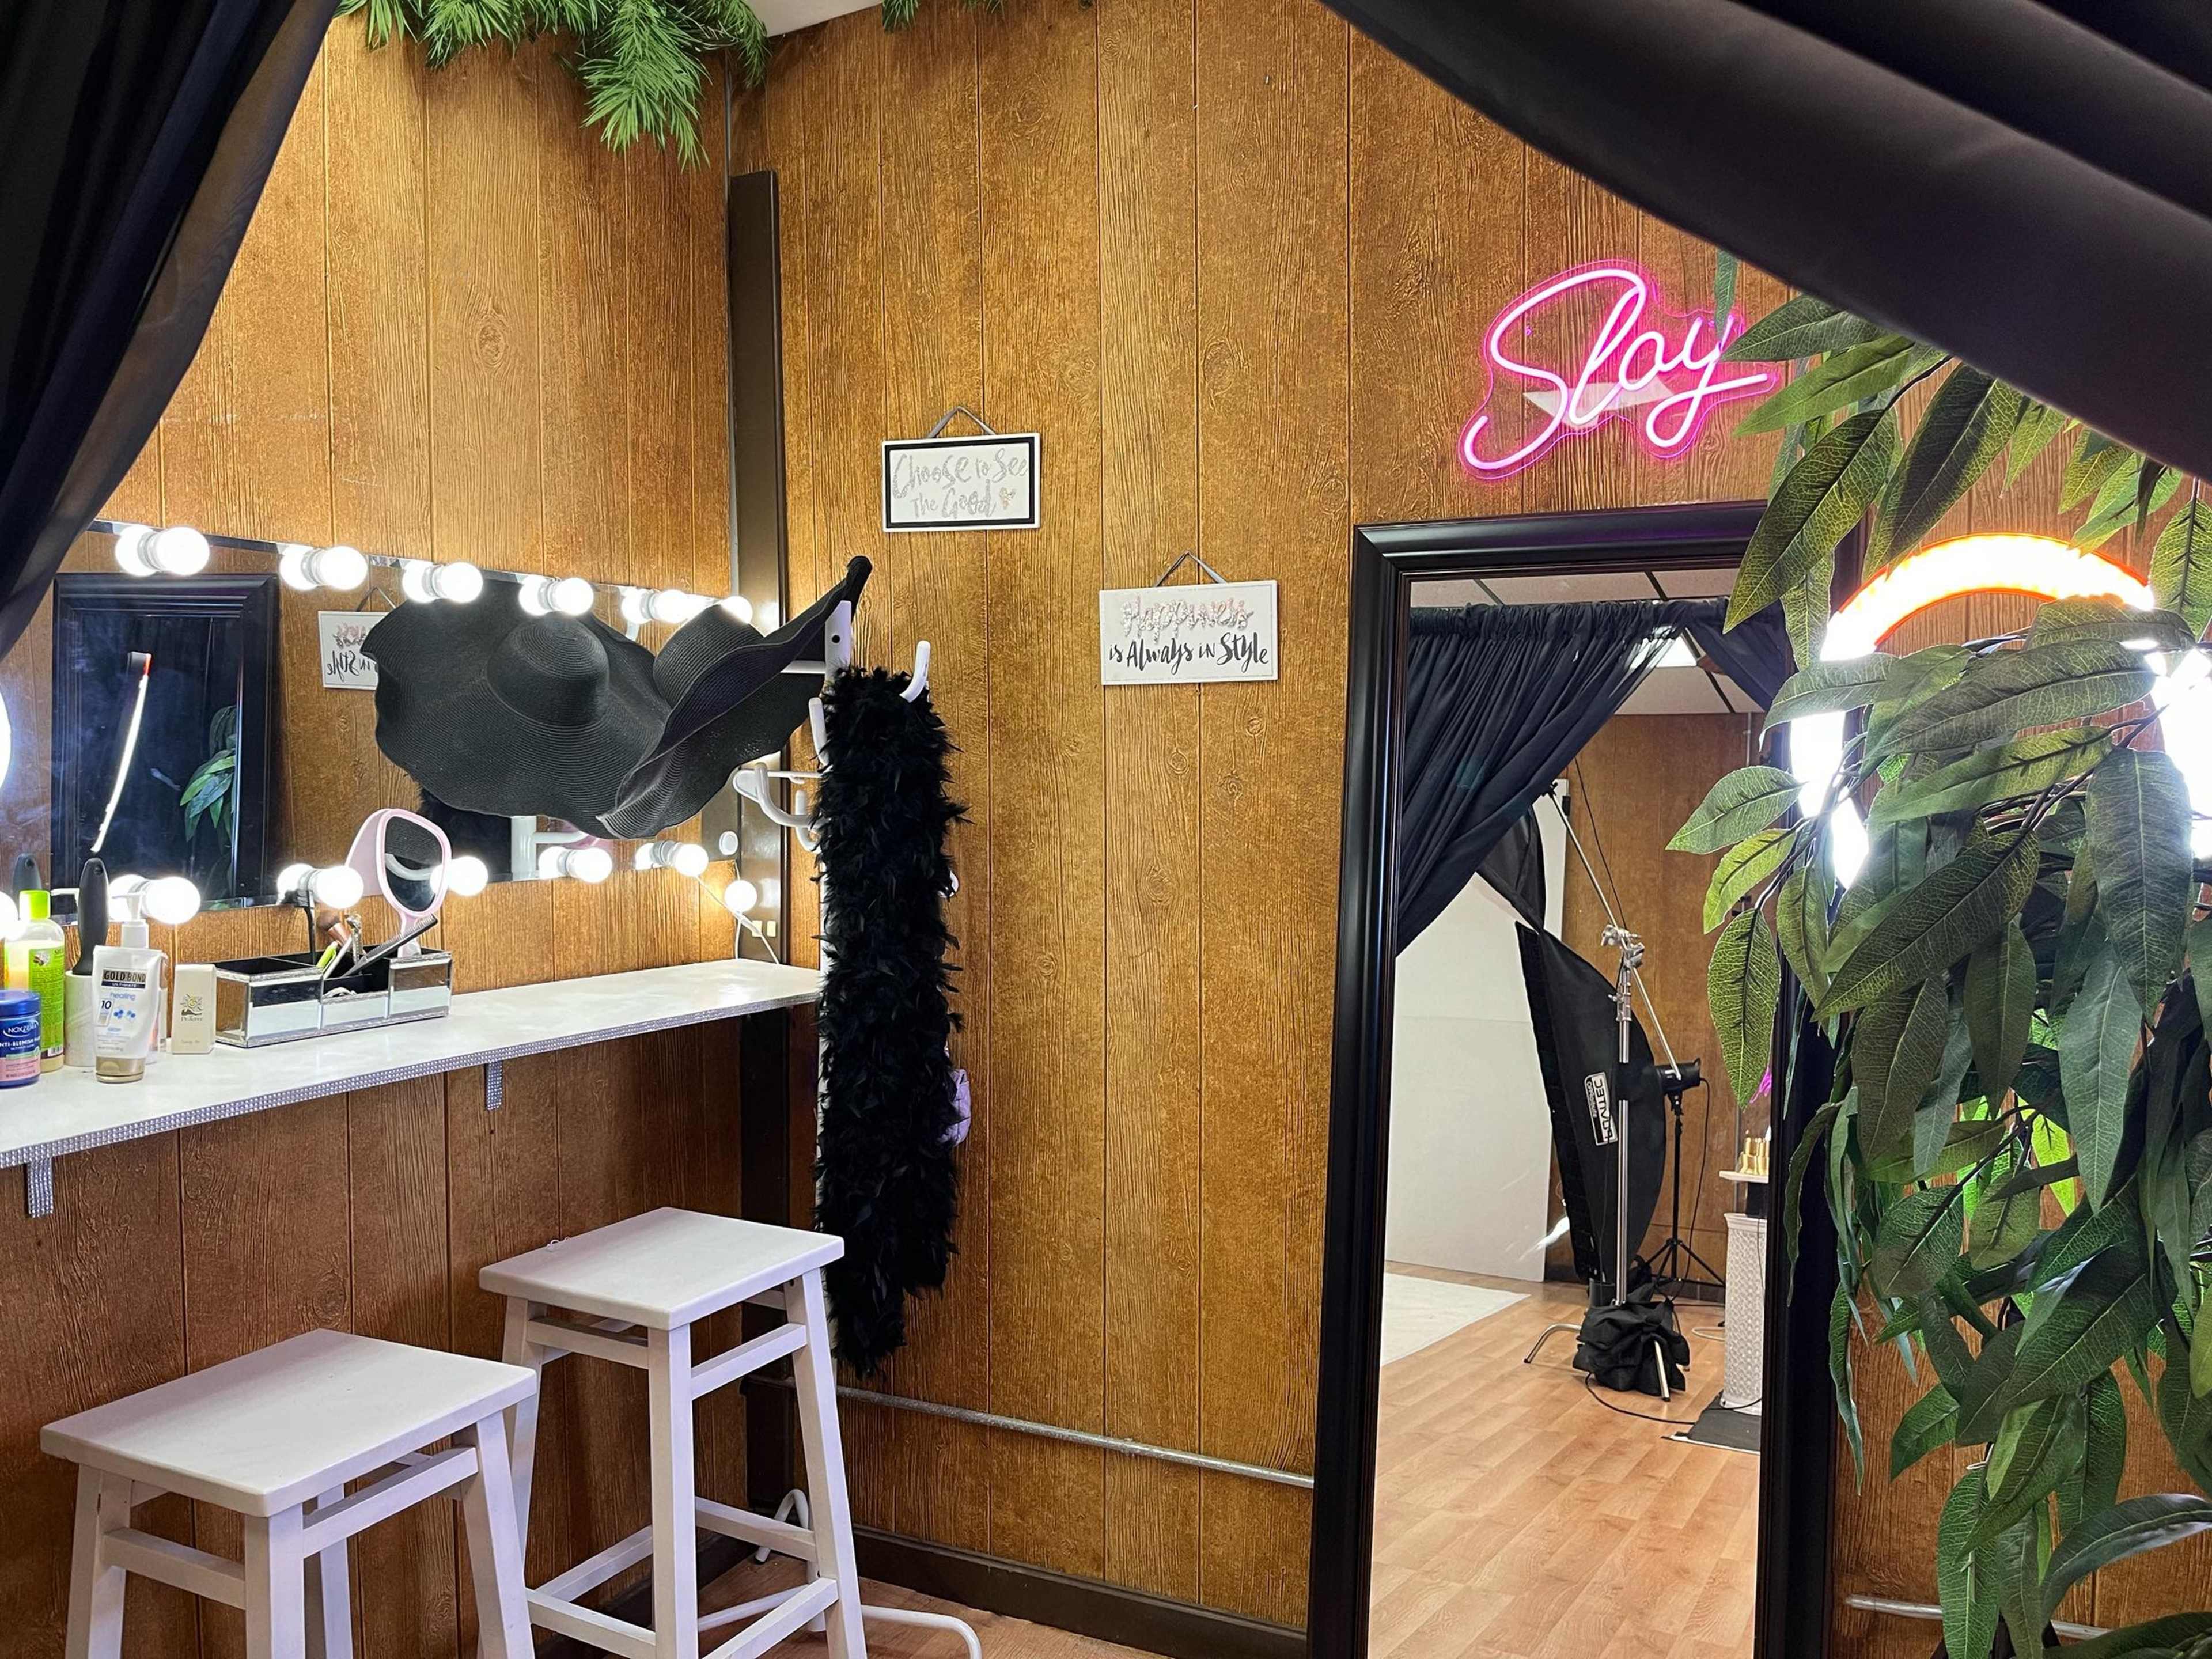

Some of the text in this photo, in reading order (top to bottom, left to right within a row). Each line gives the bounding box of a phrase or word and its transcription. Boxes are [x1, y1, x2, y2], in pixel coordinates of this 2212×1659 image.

[1464, 267, 1768, 471] Slay
[992, 448, 1028, 483] See
[941, 479, 997, 519] Good
[1109, 644, 1123, 662] is
[1127, 637, 1194, 675] Always
[1216, 632, 1268, 673] Style
[104, 971, 146, 982] GOLD BOND
[101, 1000, 112, 1009] 10
[0, 1037, 33, 1047] NTI-BLEMISH
